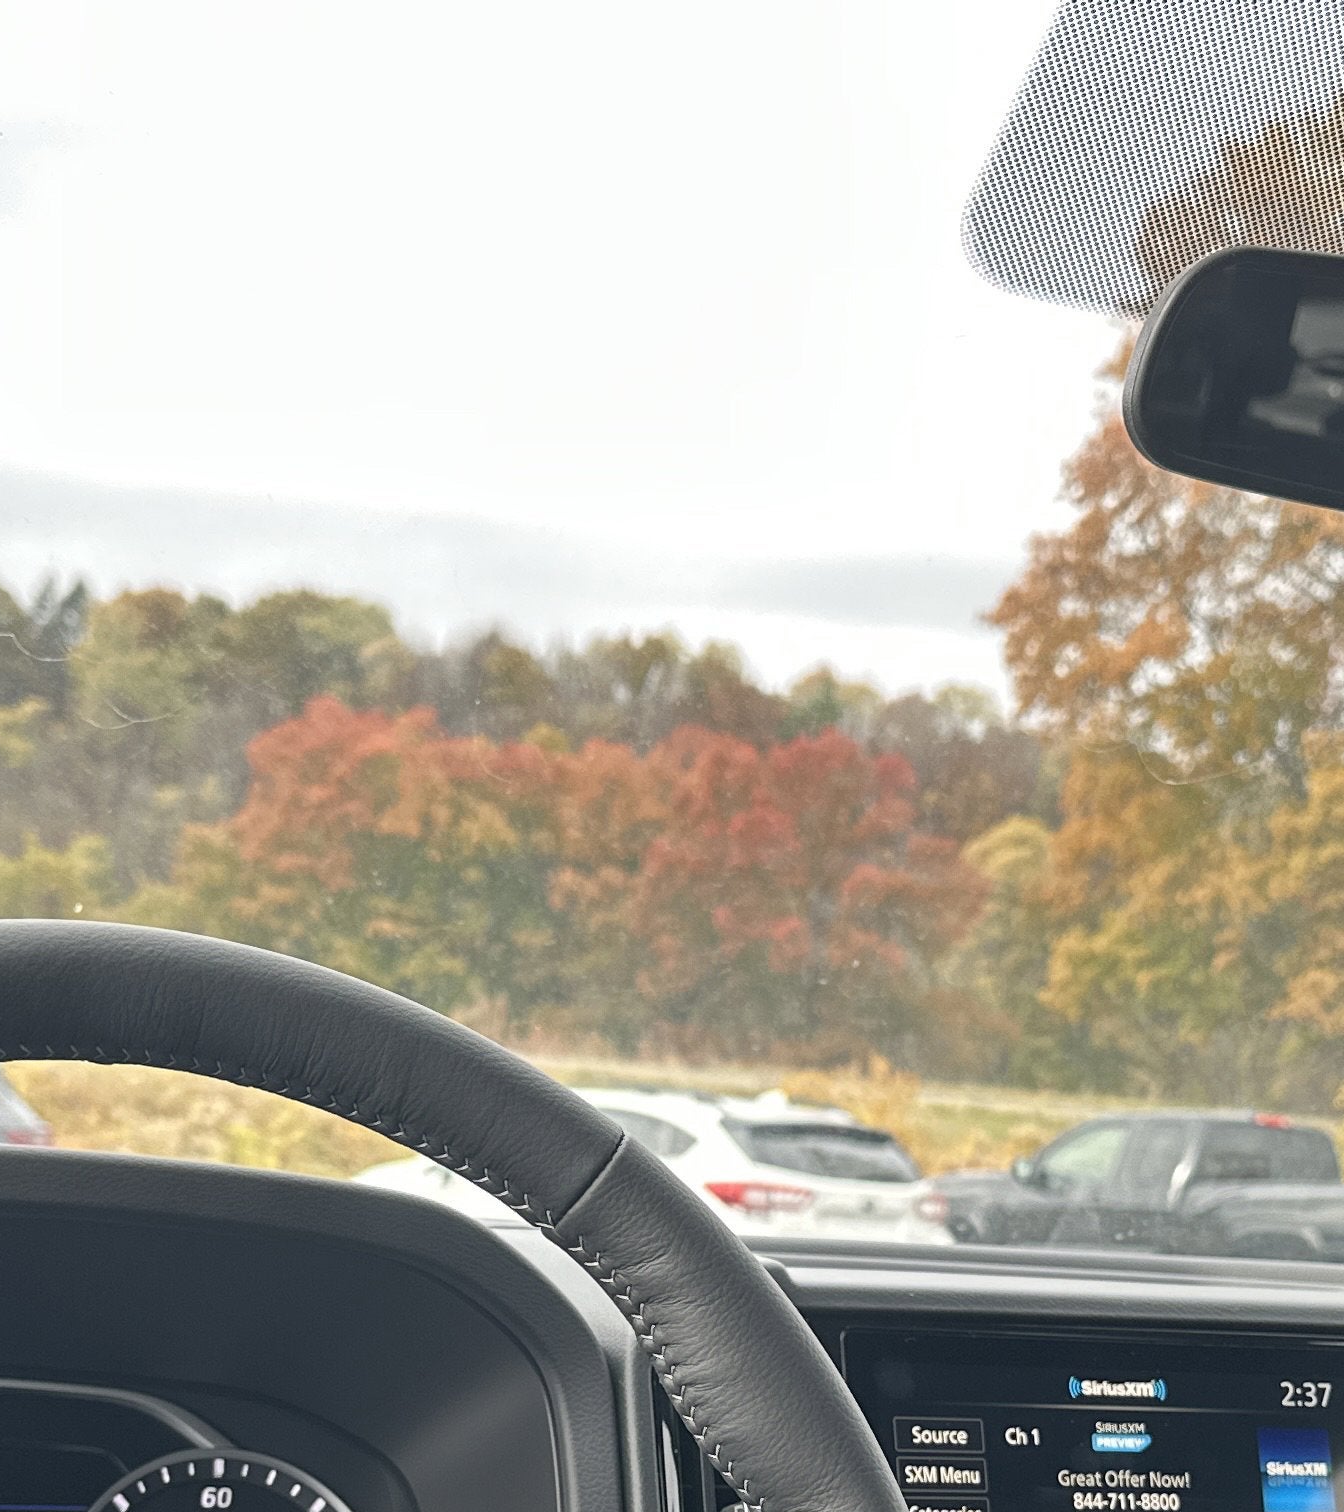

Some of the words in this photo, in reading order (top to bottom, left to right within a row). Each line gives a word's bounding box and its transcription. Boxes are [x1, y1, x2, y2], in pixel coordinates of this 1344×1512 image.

[1280, 1381, 1332, 1408] 2:37
[911, 1425, 969, 1445] Source
[1005, 1426, 1028, 1446] Ch
[1031, 1427, 1041, 1446] 1
[1096, 1437, 1146, 1448] PREVIEW
[905, 1465, 938, 1484] SXM
[939, 1466, 981, 1484] Menu
[1057, 1469, 1102, 1488] Great
[1104, 1470, 1146, 1488] Offer
[1149, 1471, 1191, 1489] Now!
[200, 1486, 232, 1509] 60
[1073, 1492, 1180, 1511] 844-711-8800
